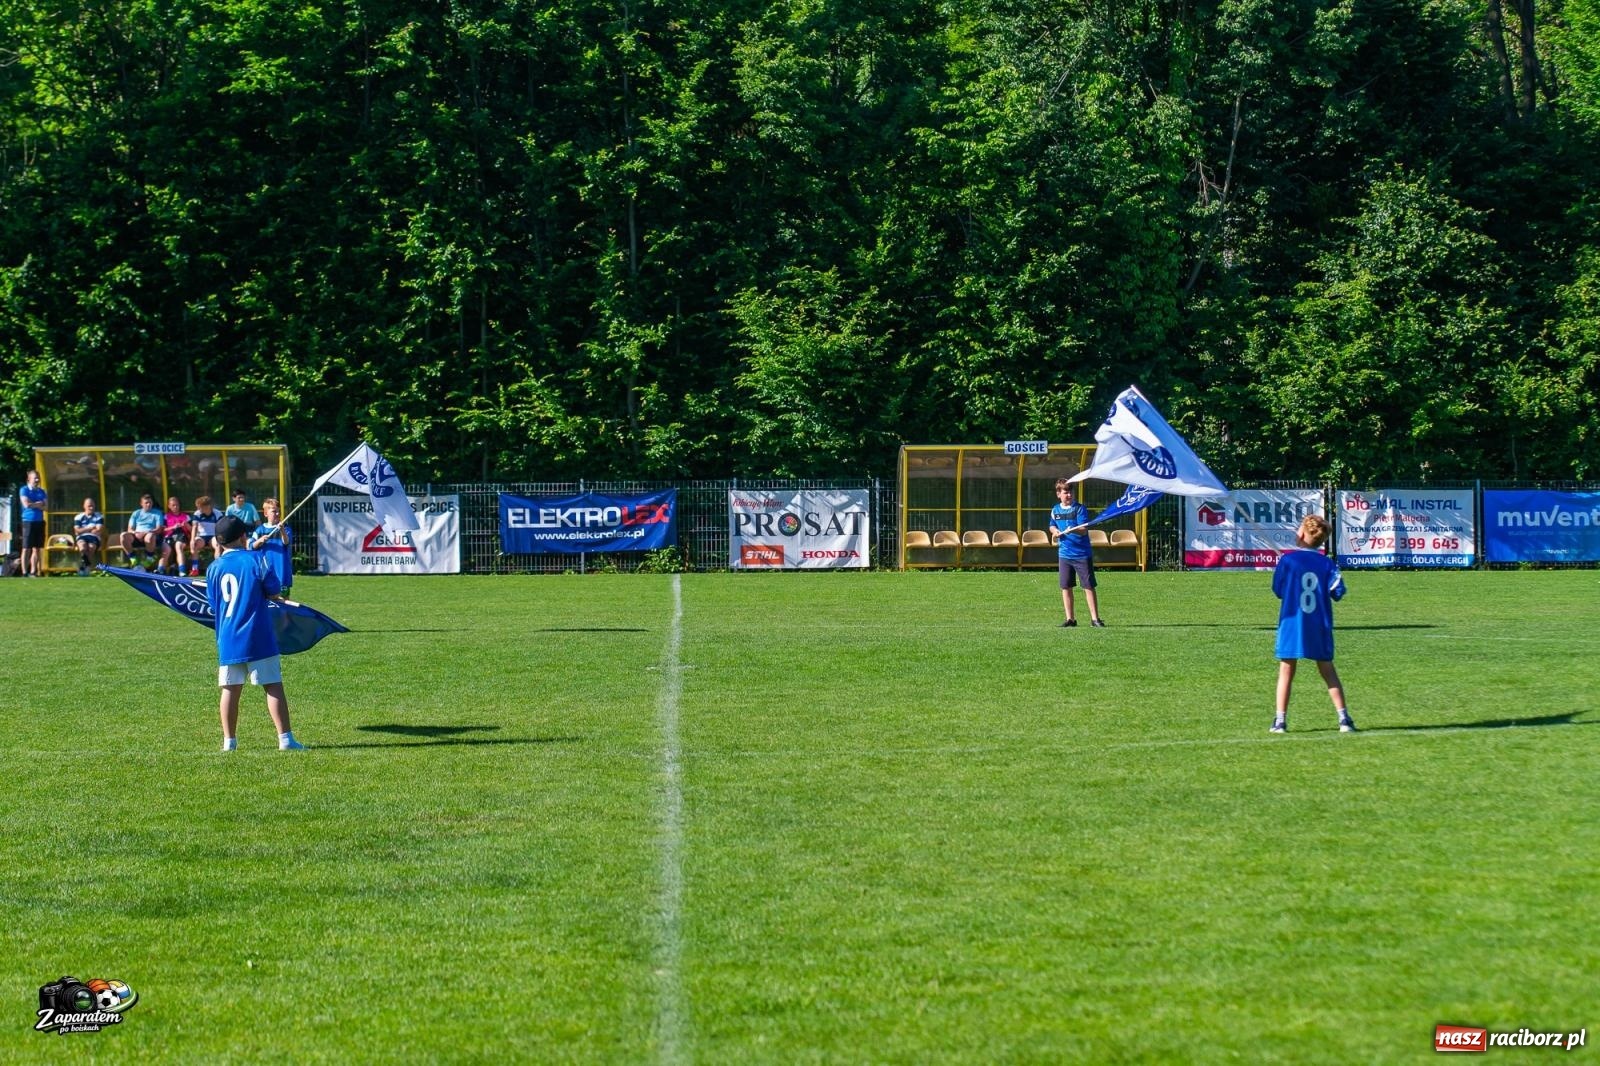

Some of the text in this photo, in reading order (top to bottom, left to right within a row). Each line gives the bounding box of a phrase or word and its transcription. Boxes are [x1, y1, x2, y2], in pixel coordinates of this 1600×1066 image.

[146, 444, 184, 453] LKS OCICE
[1007, 441, 1046, 453] GOŚCIE
[323, 502, 374, 513] WSPIERA
[1411, 499, 1463, 511] INSTAL
[507, 503, 670, 528] ELEKTROLEX
[1497, 504, 1600, 527] muvent
[733, 511, 867, 537] PROSAT
[534, 528, 645, 541] www.elektrolex.pl
[1369, 538, 1460, 550] 792 399 645
[360, 556, 417, 565] GALERIA BARW
[745, 550, 780, 560] STIHL
[802, 550, 860, 559] HONDA
[1235, 553, 1284, 564] frbarko.p
[220, 573, 240, 618] 9
[1300, 571, 1319, 614] 8
